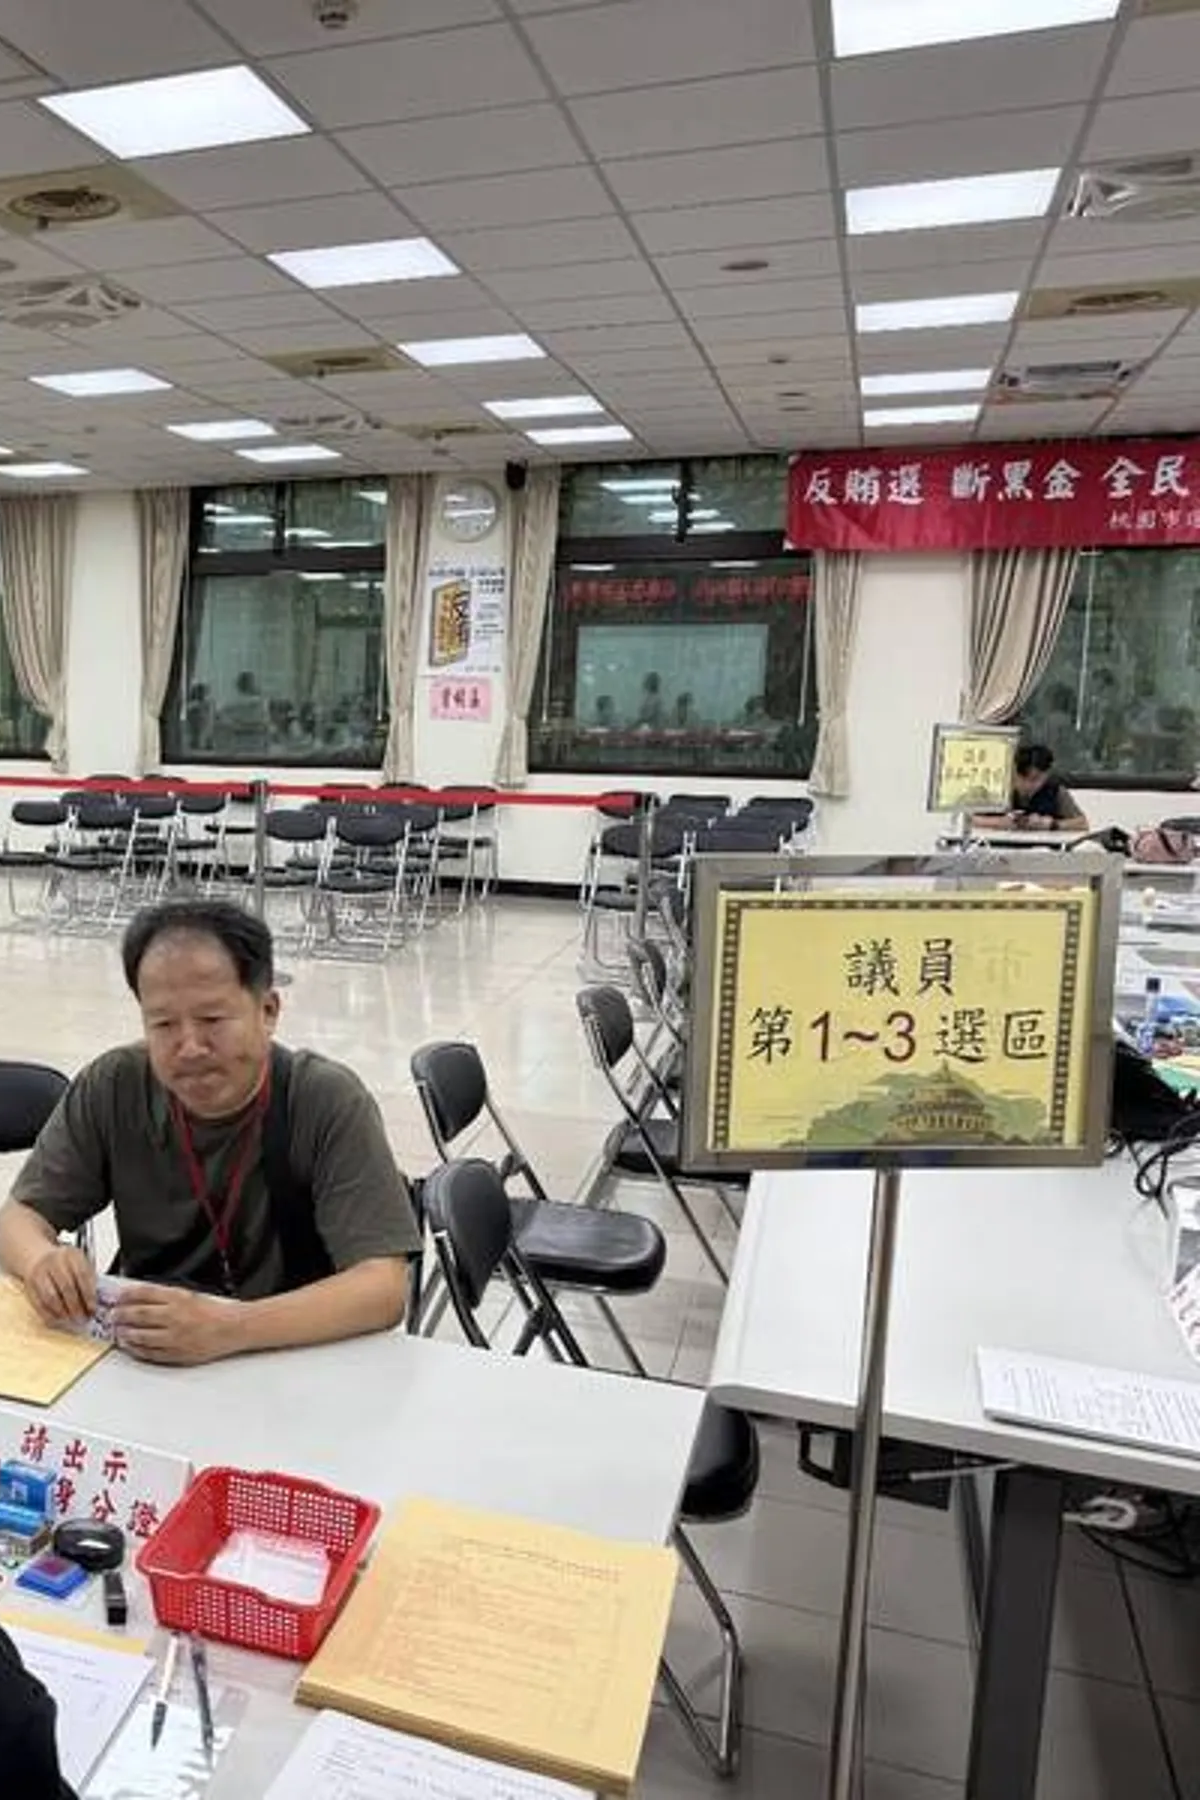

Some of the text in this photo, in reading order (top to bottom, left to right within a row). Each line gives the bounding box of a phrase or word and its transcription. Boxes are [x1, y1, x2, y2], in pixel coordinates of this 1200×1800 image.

[803, 455, 1191, 506] 反賄選 斷黑金 全民
[843, 937, 956, 997] 議員
[746, 1004, 1050, 1066] 第1~3選區
[20, 1422, 129, 1484] 請出示
